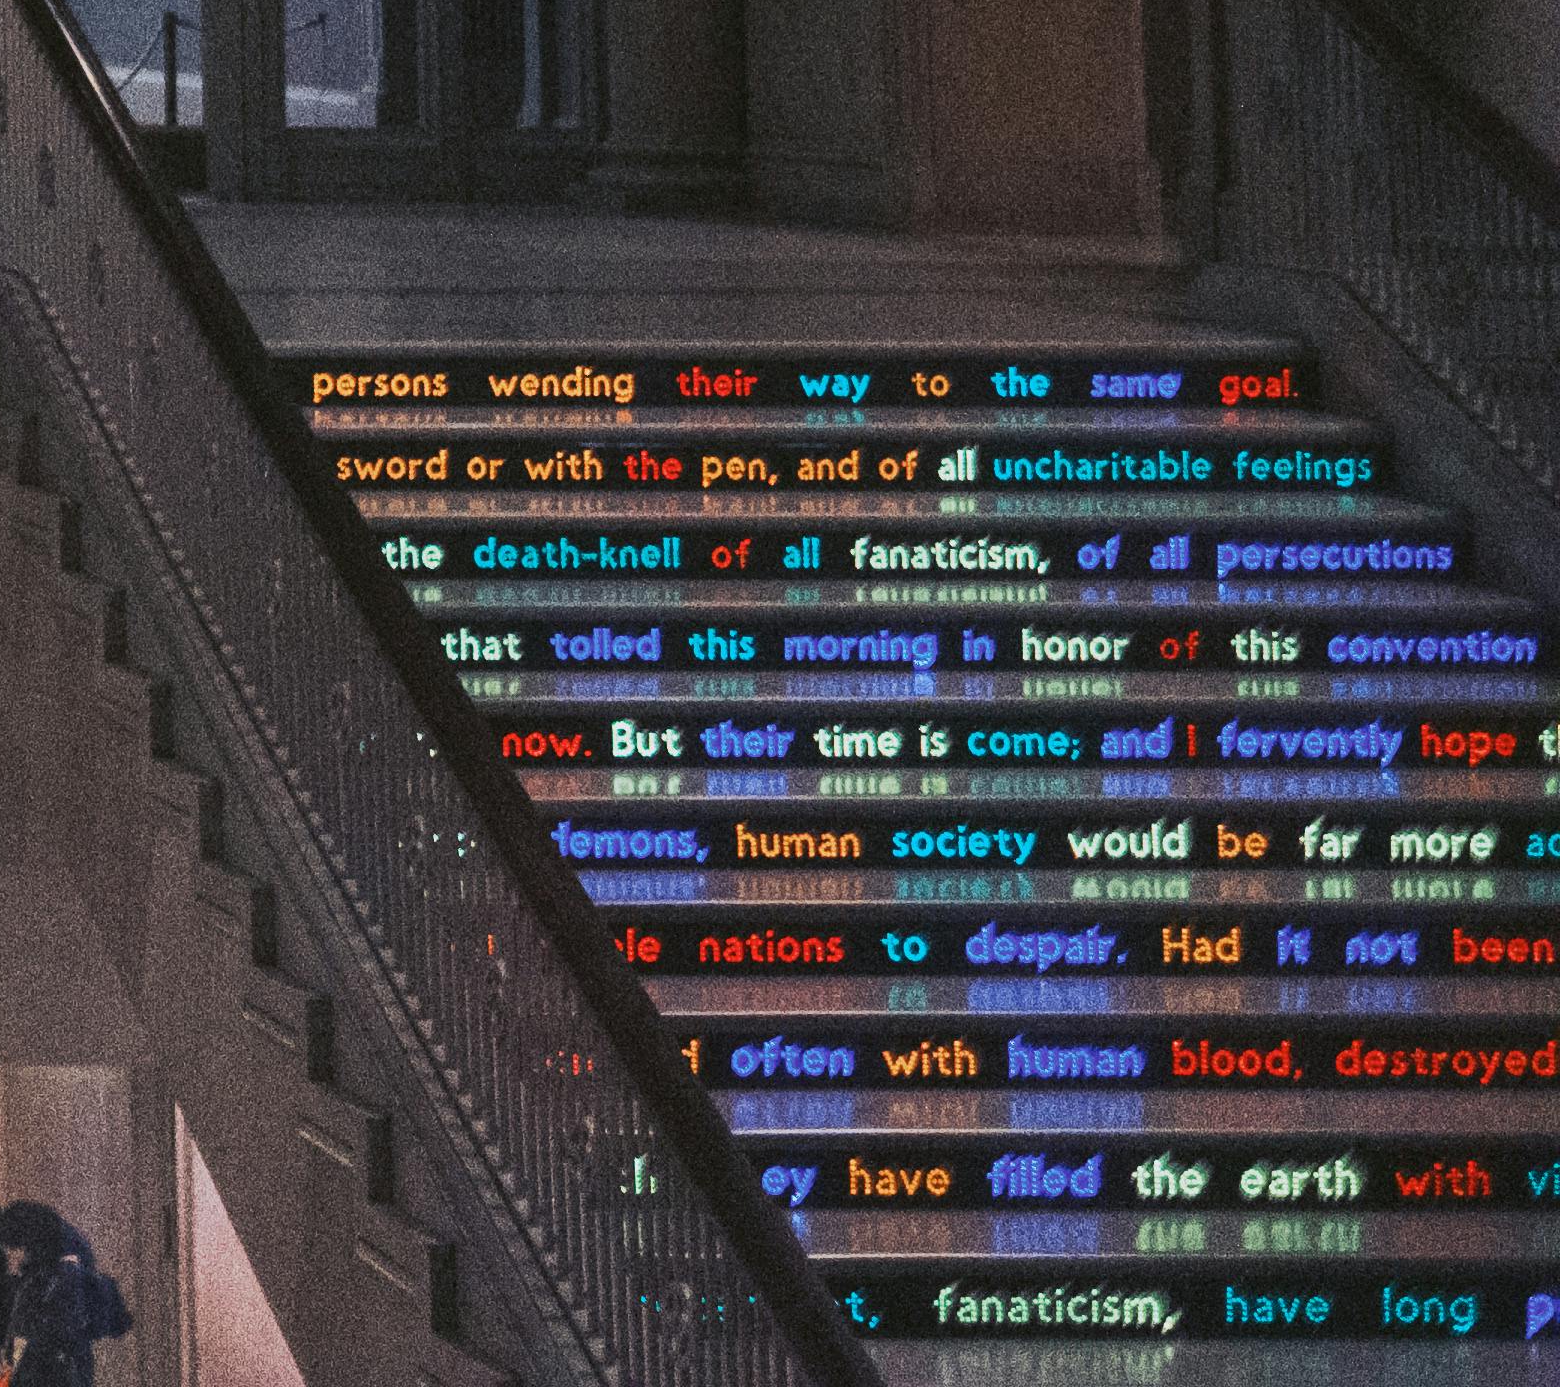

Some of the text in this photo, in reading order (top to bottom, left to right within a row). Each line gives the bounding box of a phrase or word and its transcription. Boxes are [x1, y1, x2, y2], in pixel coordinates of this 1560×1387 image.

[313, 366, 1299, 405] persons wending their way to the same goal.
[337, 447, 1371, 488] sword or with the pen, and of all uncharitable feelings
[382, 535, 1452, 577] the death-knell of all fanaticism, of all persecutions
[441, 627, 1538, 669] that tolled this morning honor of this convention
[502, 717, 1516, 768] now. But their time is come; and fervently hope
[736, 818, 1496, 865] human society would be far more
[699, 921, 1554, 972] nations to despair. Had not been
[731, 1034, 1557, 1084] often with human blood, destroyed
[849, 1153, 1489, 1199] have filled the earth with
[933, 1286, 1475, 1333] fanaticism, have long
